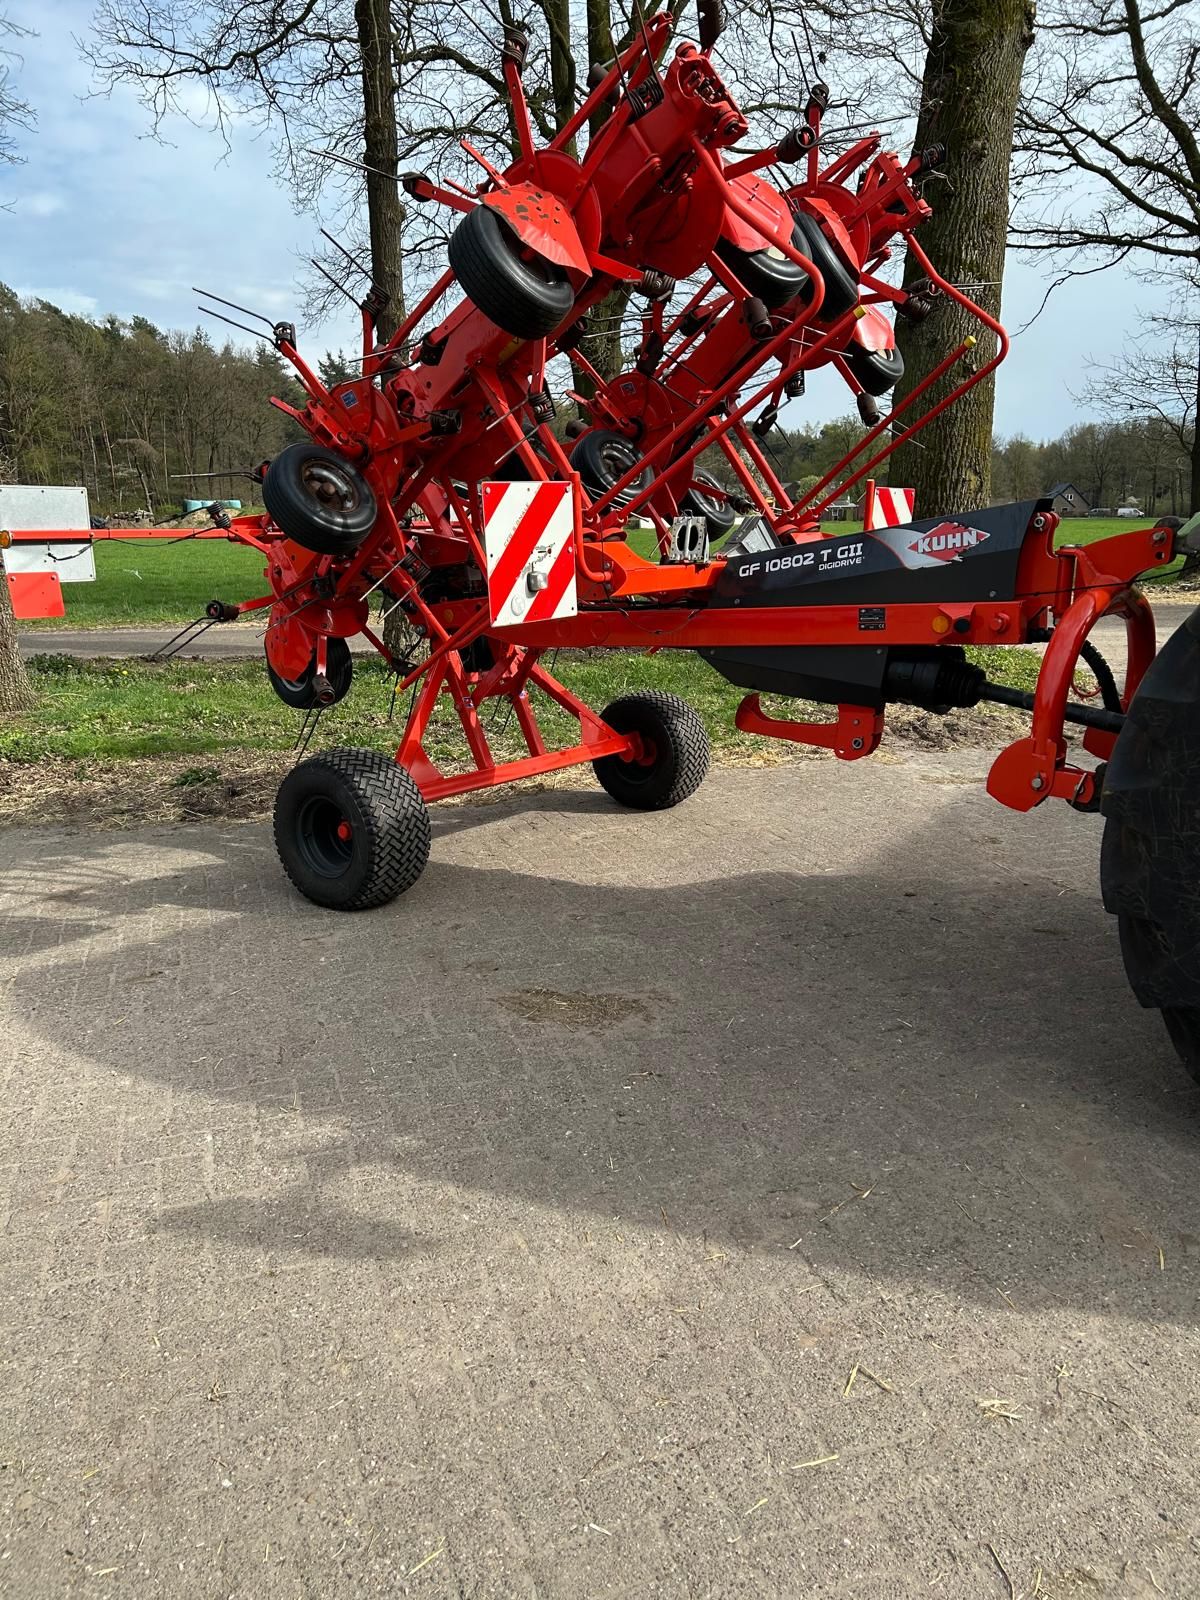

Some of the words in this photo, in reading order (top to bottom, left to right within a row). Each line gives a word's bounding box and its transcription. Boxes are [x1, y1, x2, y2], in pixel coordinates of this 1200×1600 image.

[917, 530, 977, 553] KUHN
[739, 563, 760, 577] GF
[765, 552, 815, 573] 10802
[820, 549, 832, 562] T
[837, 542, 863, 559] GII
[818, 556, 863, 571] DIGIDRIVE
